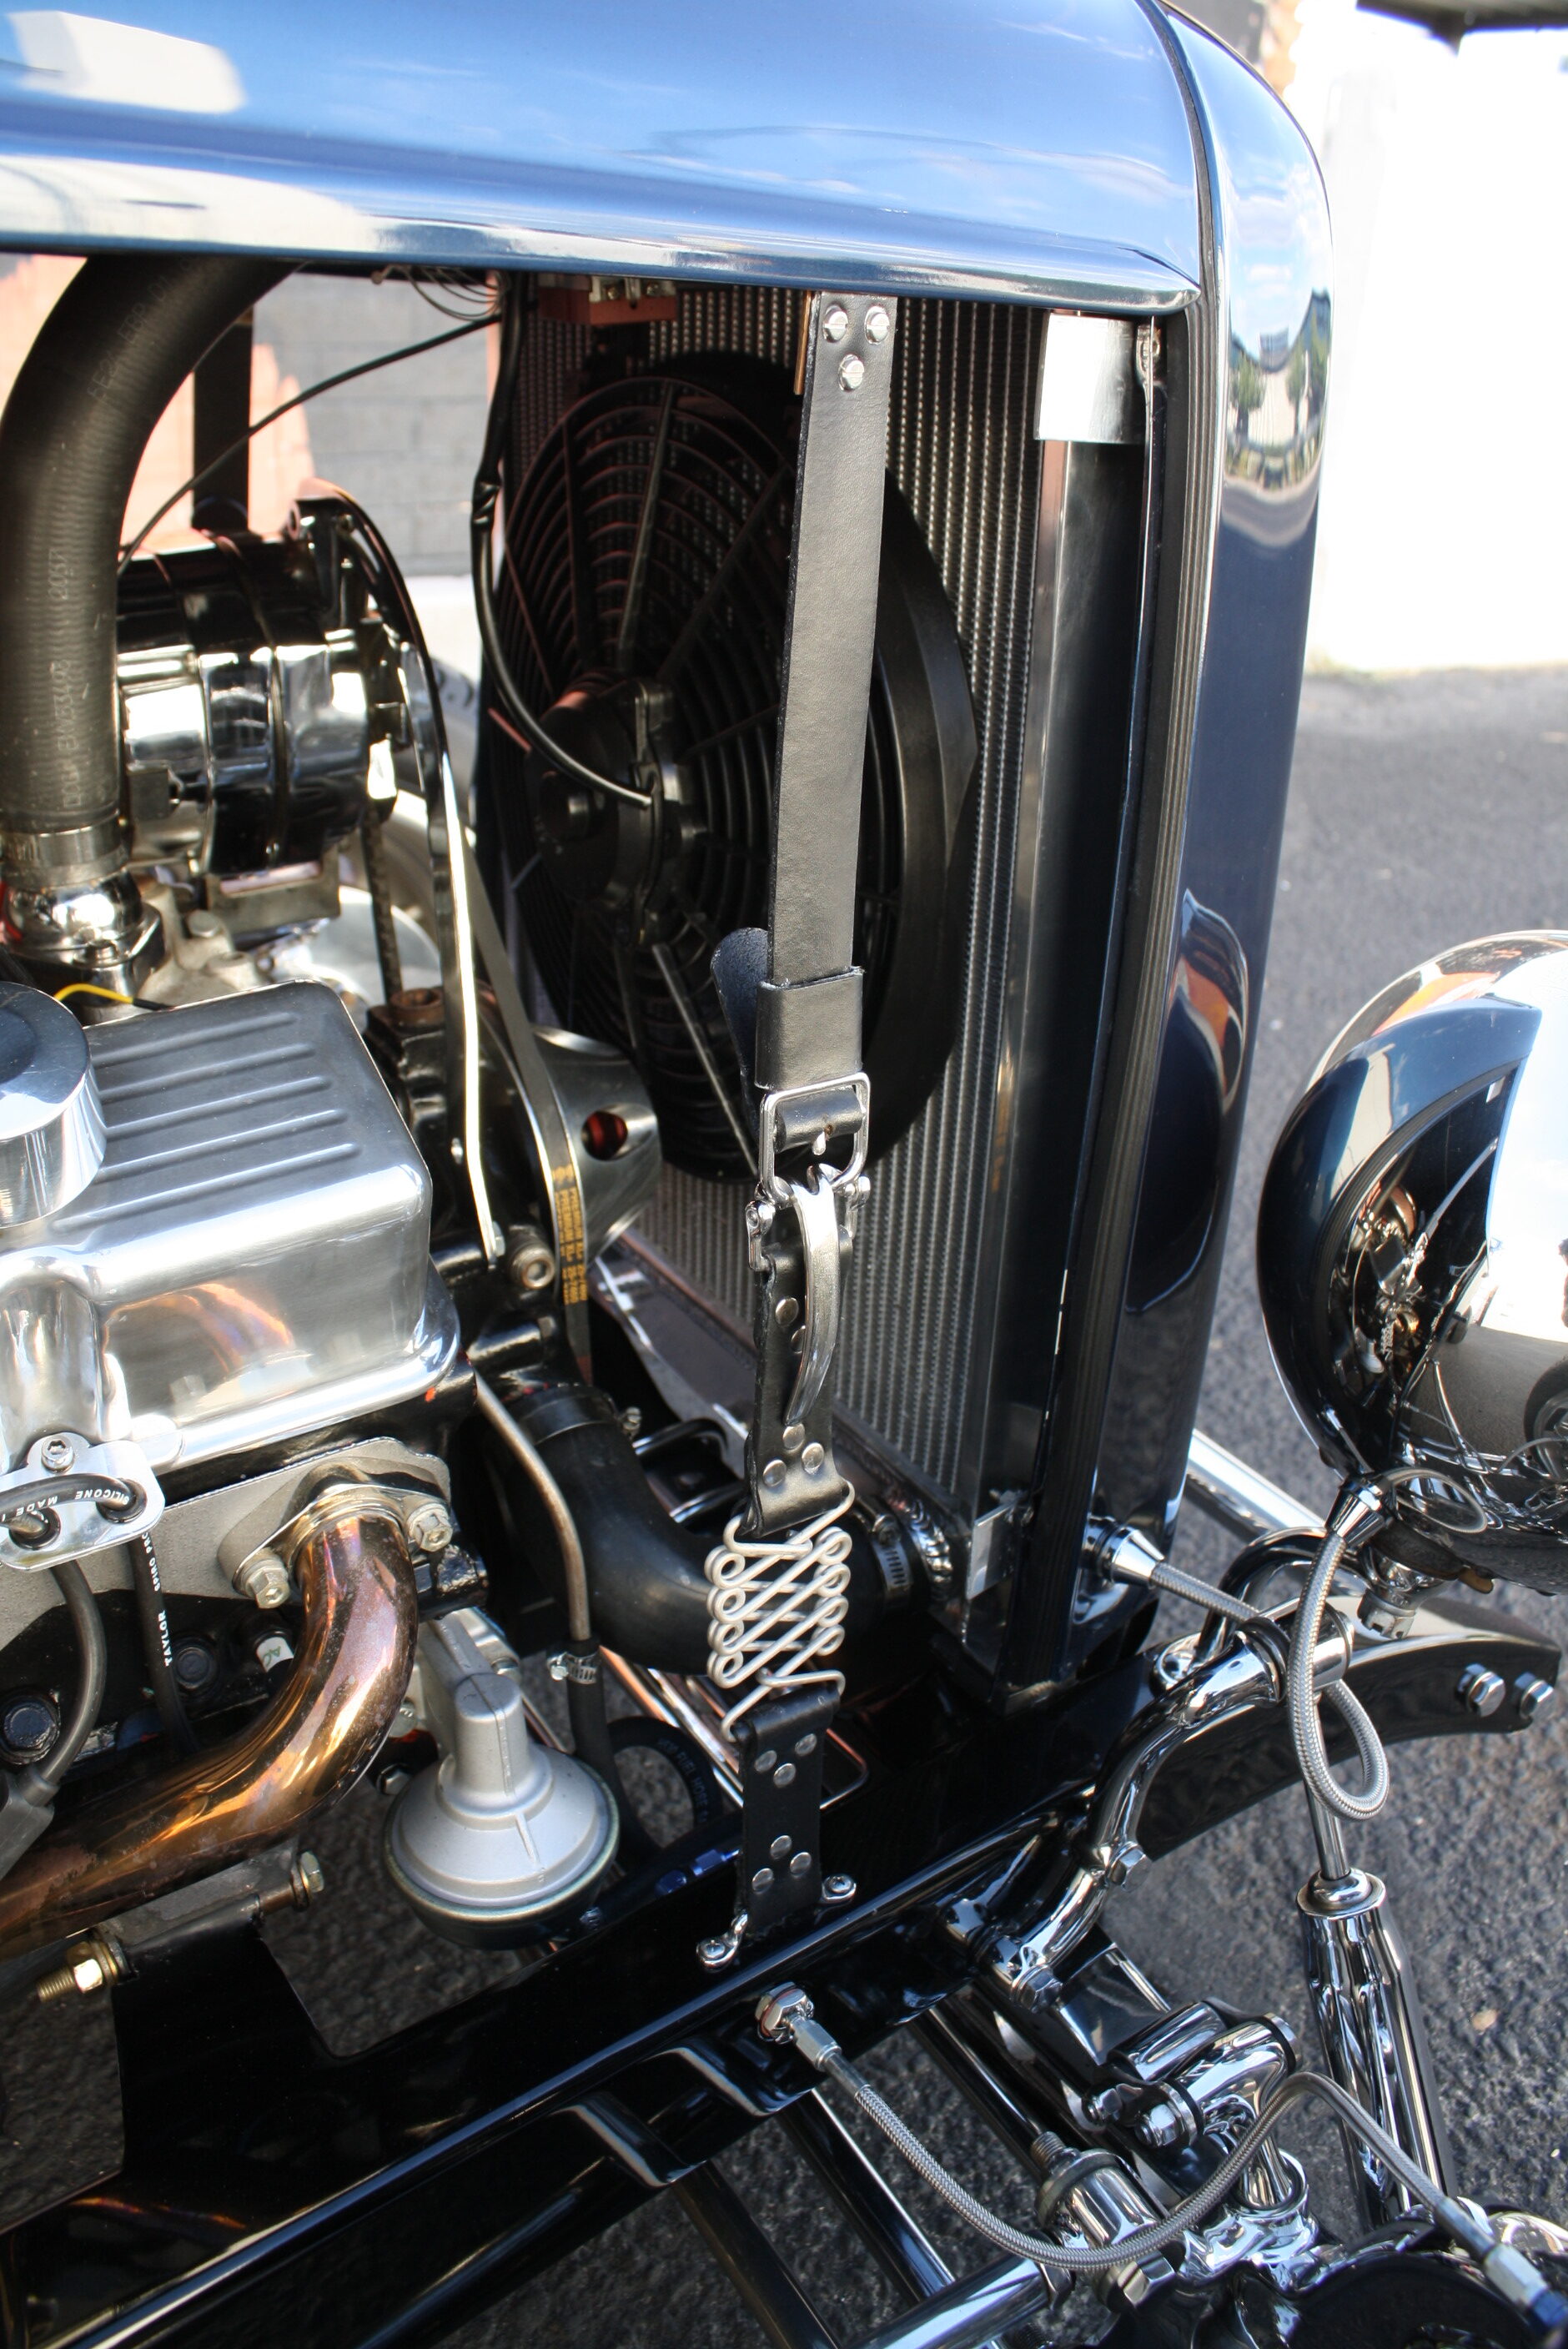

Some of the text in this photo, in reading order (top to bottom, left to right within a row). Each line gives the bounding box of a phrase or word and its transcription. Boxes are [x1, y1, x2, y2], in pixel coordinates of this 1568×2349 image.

[16, 1495, 58, 1517] MADE
[75, 1489, 130, 1506] SILICONE
[148, 1557, 160, 1592] SPIRO
[158, 1610, 173, 1667] TAYLOR
